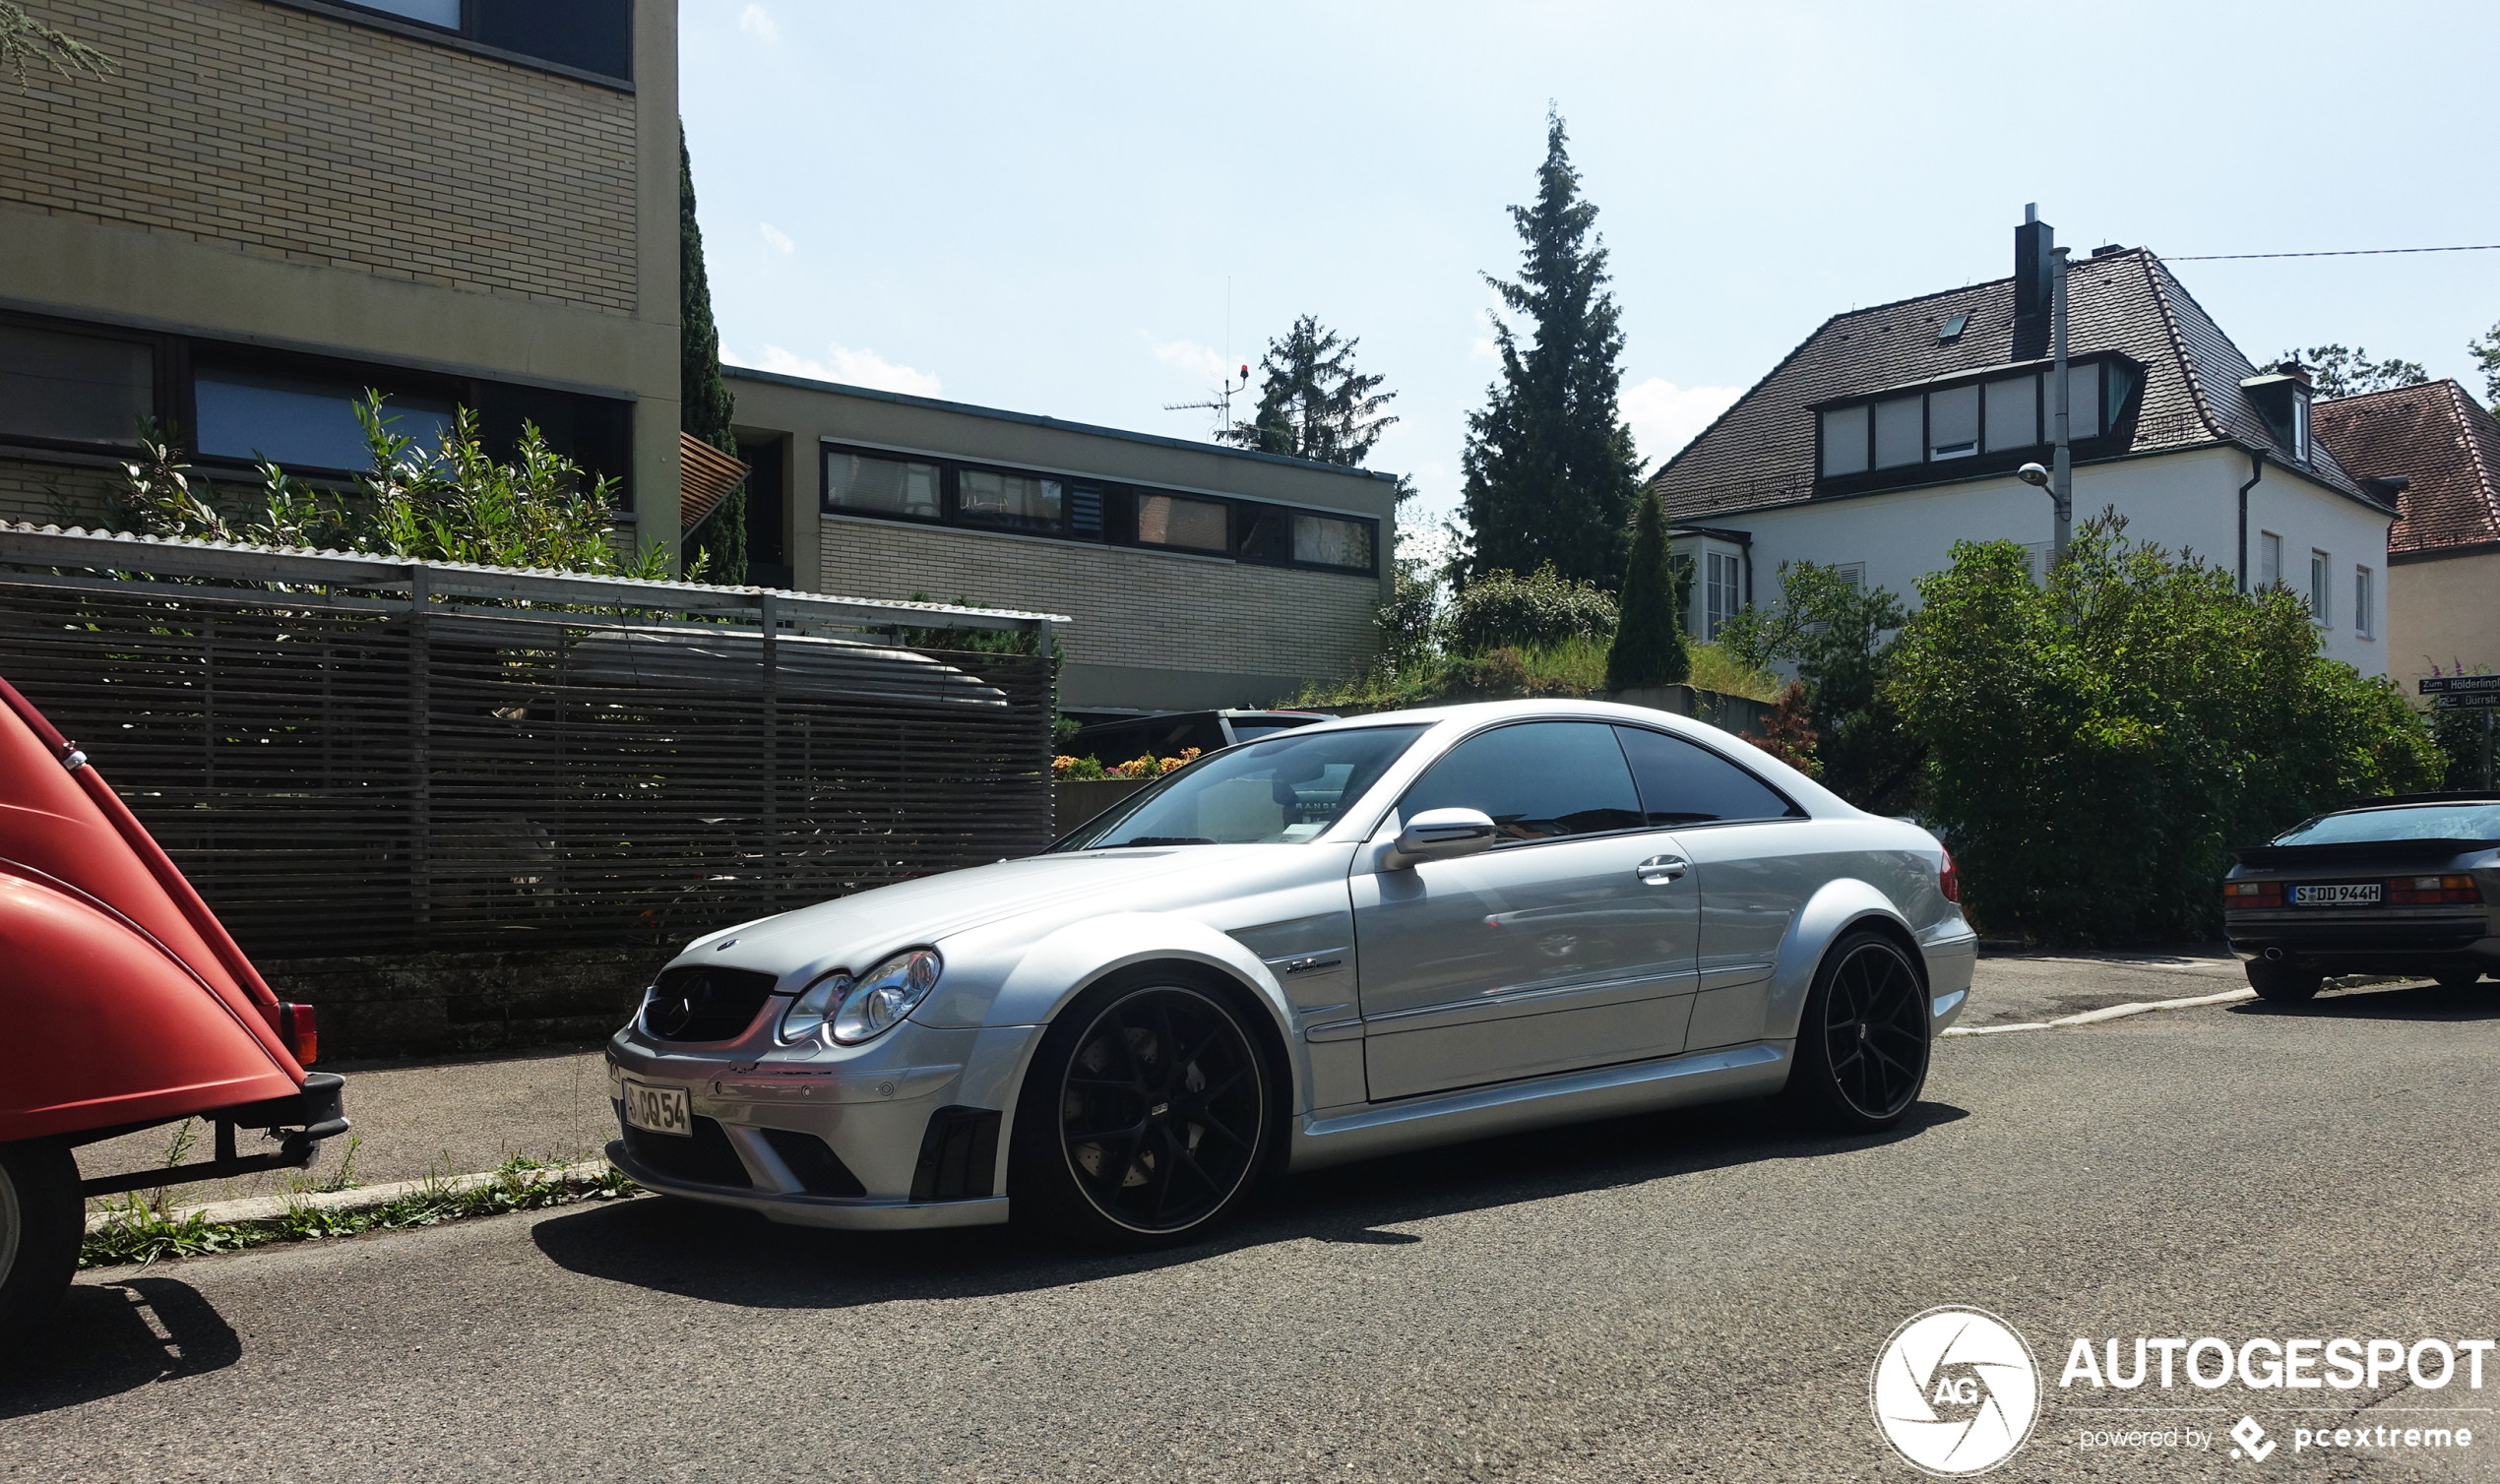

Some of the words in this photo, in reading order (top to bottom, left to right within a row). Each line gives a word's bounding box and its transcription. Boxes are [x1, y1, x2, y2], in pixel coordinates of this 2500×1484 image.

[2296, 887, 2307, 901] S
[2317, 887, 2337, 900] DD
[2340, 886, 2379, 900] 944H
[660, 1092, 686, 1130] 54
